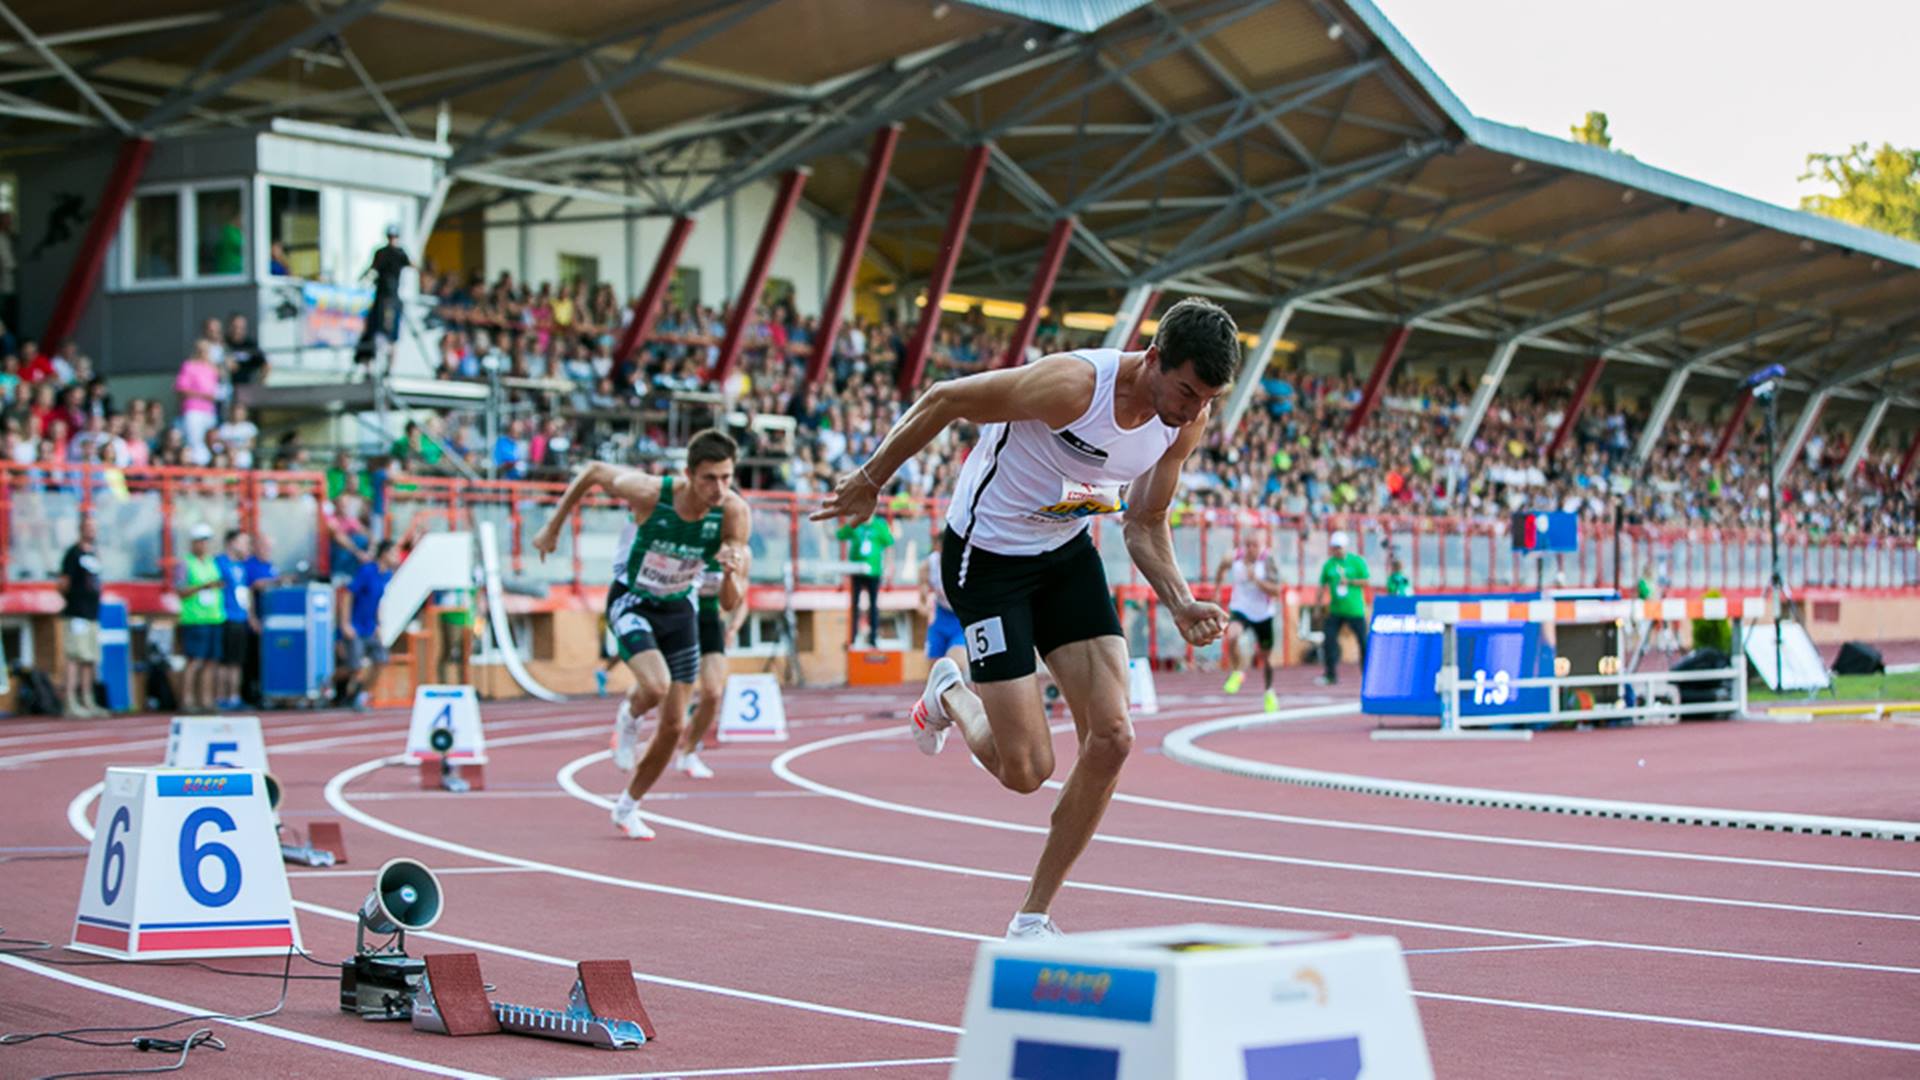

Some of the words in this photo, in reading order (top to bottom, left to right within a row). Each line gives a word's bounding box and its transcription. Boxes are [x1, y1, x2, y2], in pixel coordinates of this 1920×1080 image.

[975, 626, 989, 654] 5
[740, 688, 761, 722] 3
[101, 805, 131, 906] 6
[178, 806, 242, 908] 6
